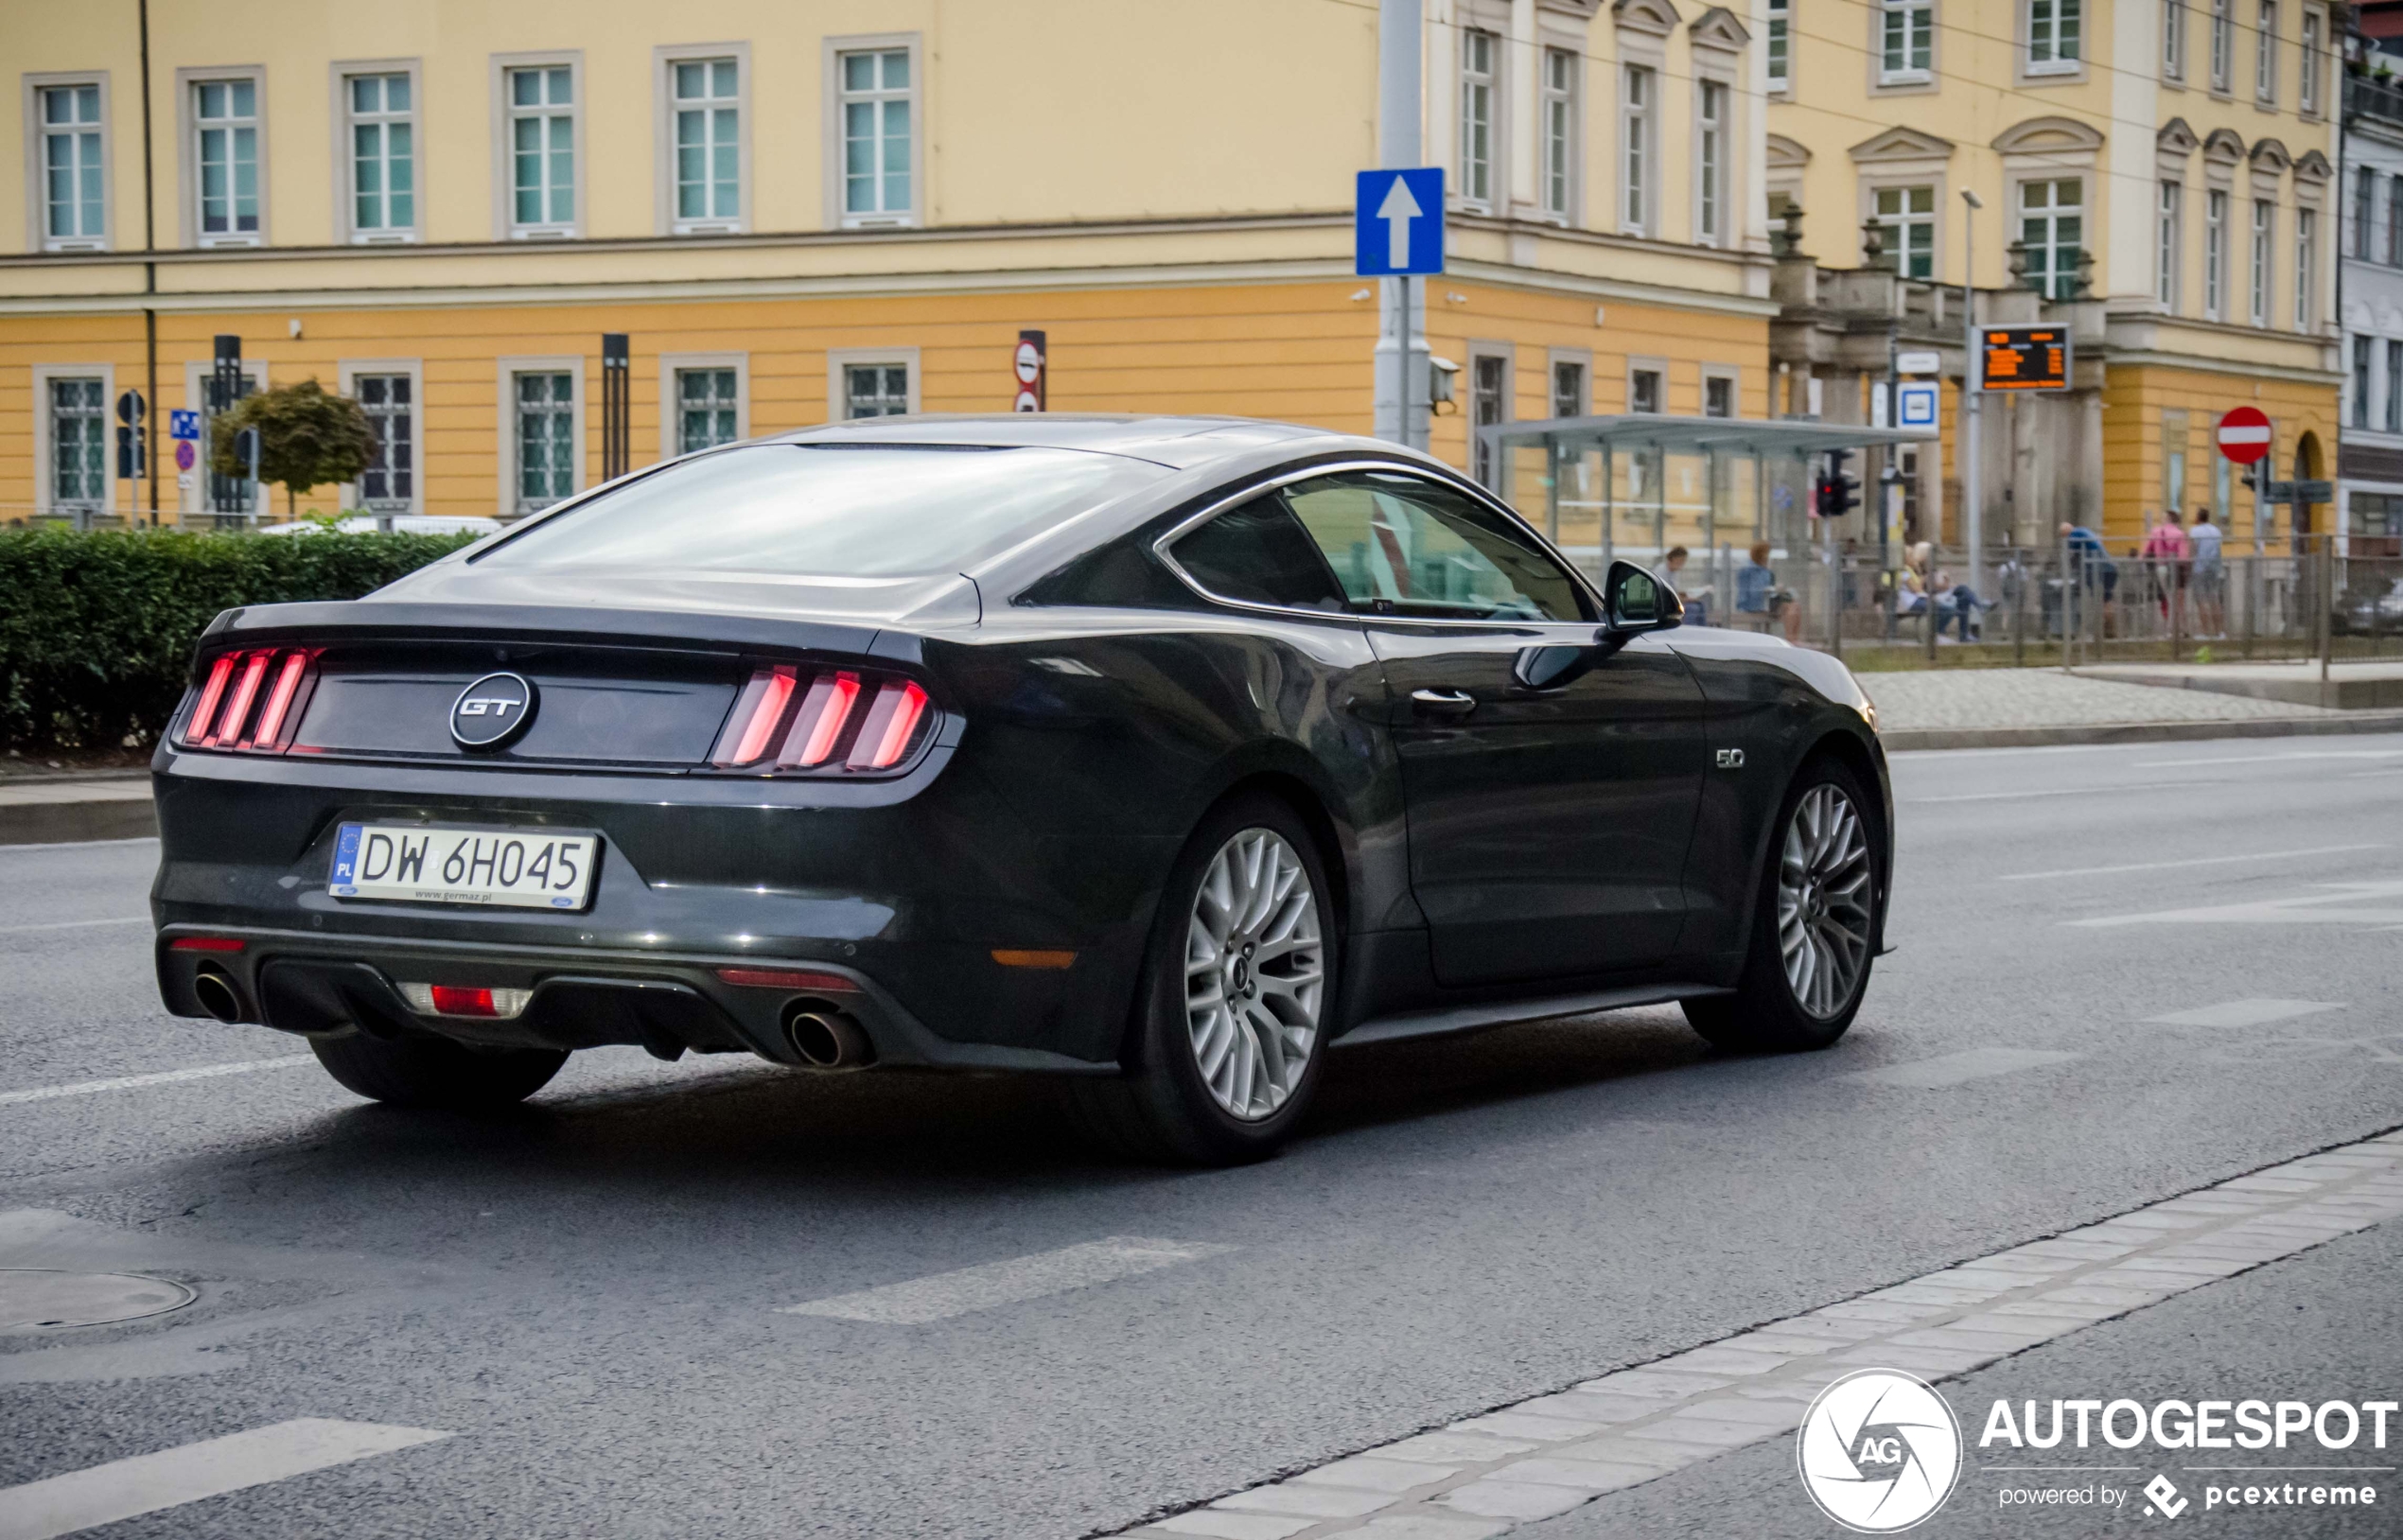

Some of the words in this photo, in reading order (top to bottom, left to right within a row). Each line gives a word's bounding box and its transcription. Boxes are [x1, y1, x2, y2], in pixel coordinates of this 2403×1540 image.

[460, 698, 521, 716] GT
[361, 833, 430, 883] DW
[443, 837, 581, 890] 6H045
[337, 863, 352, 877] PL
[415, 890, 492, 903] www.germaz.pl
